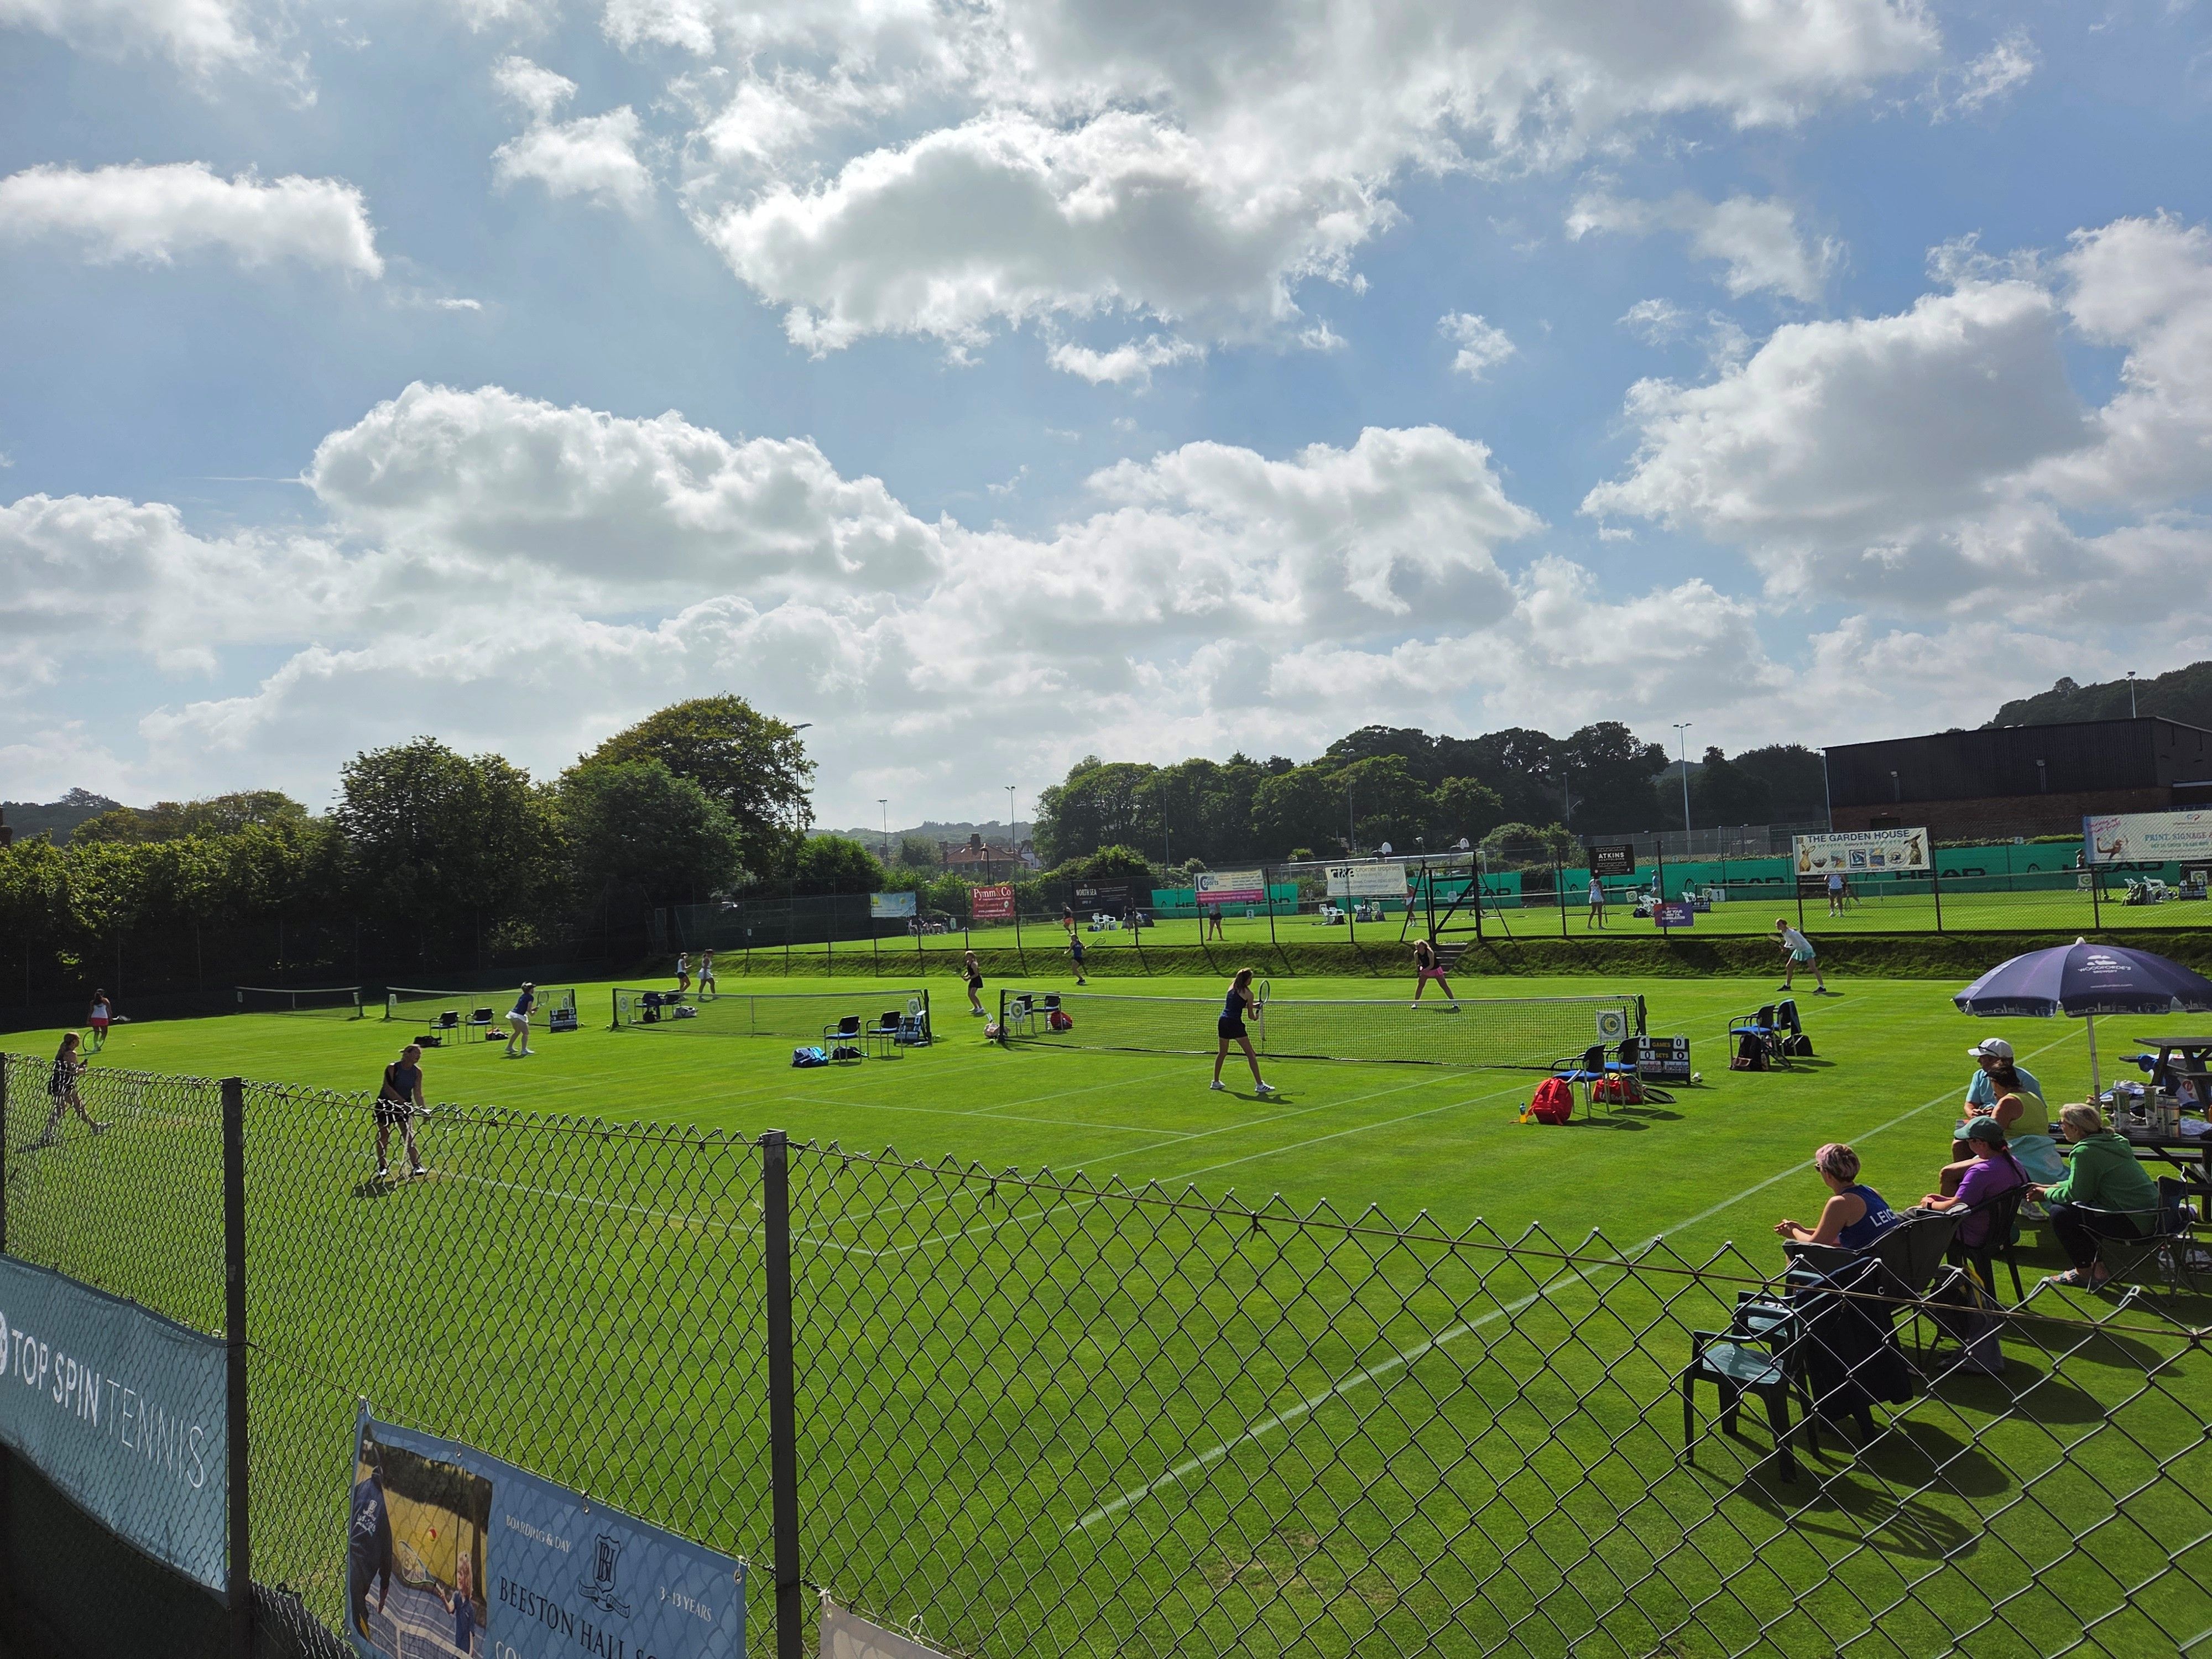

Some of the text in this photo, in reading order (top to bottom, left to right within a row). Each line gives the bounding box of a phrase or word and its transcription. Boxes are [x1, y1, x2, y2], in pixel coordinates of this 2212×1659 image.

[1829, 833, 1871, 842] GARDEN
[1874, 830, 1910, 840] HOUSE
[2173, 832, 2207, 840] SIGNAGE
[1896, 868, 1986, 880] HEAD
[1709, 877, 1785, 889] HEAD
[973, 888, 996, 901] Pymm
[1001, 886, 1011, 896] Co
[1599, 1092, 1630, 1102] Wlson
[12, 1329, 205, 1489] TOP SPIN TENNIS
[506, 1514, 571, 1553] BOARDING & DAY
[684, 1596, 712, 1622] YEARS
[499, 1576, 624, 1659] BEESTON HALL
